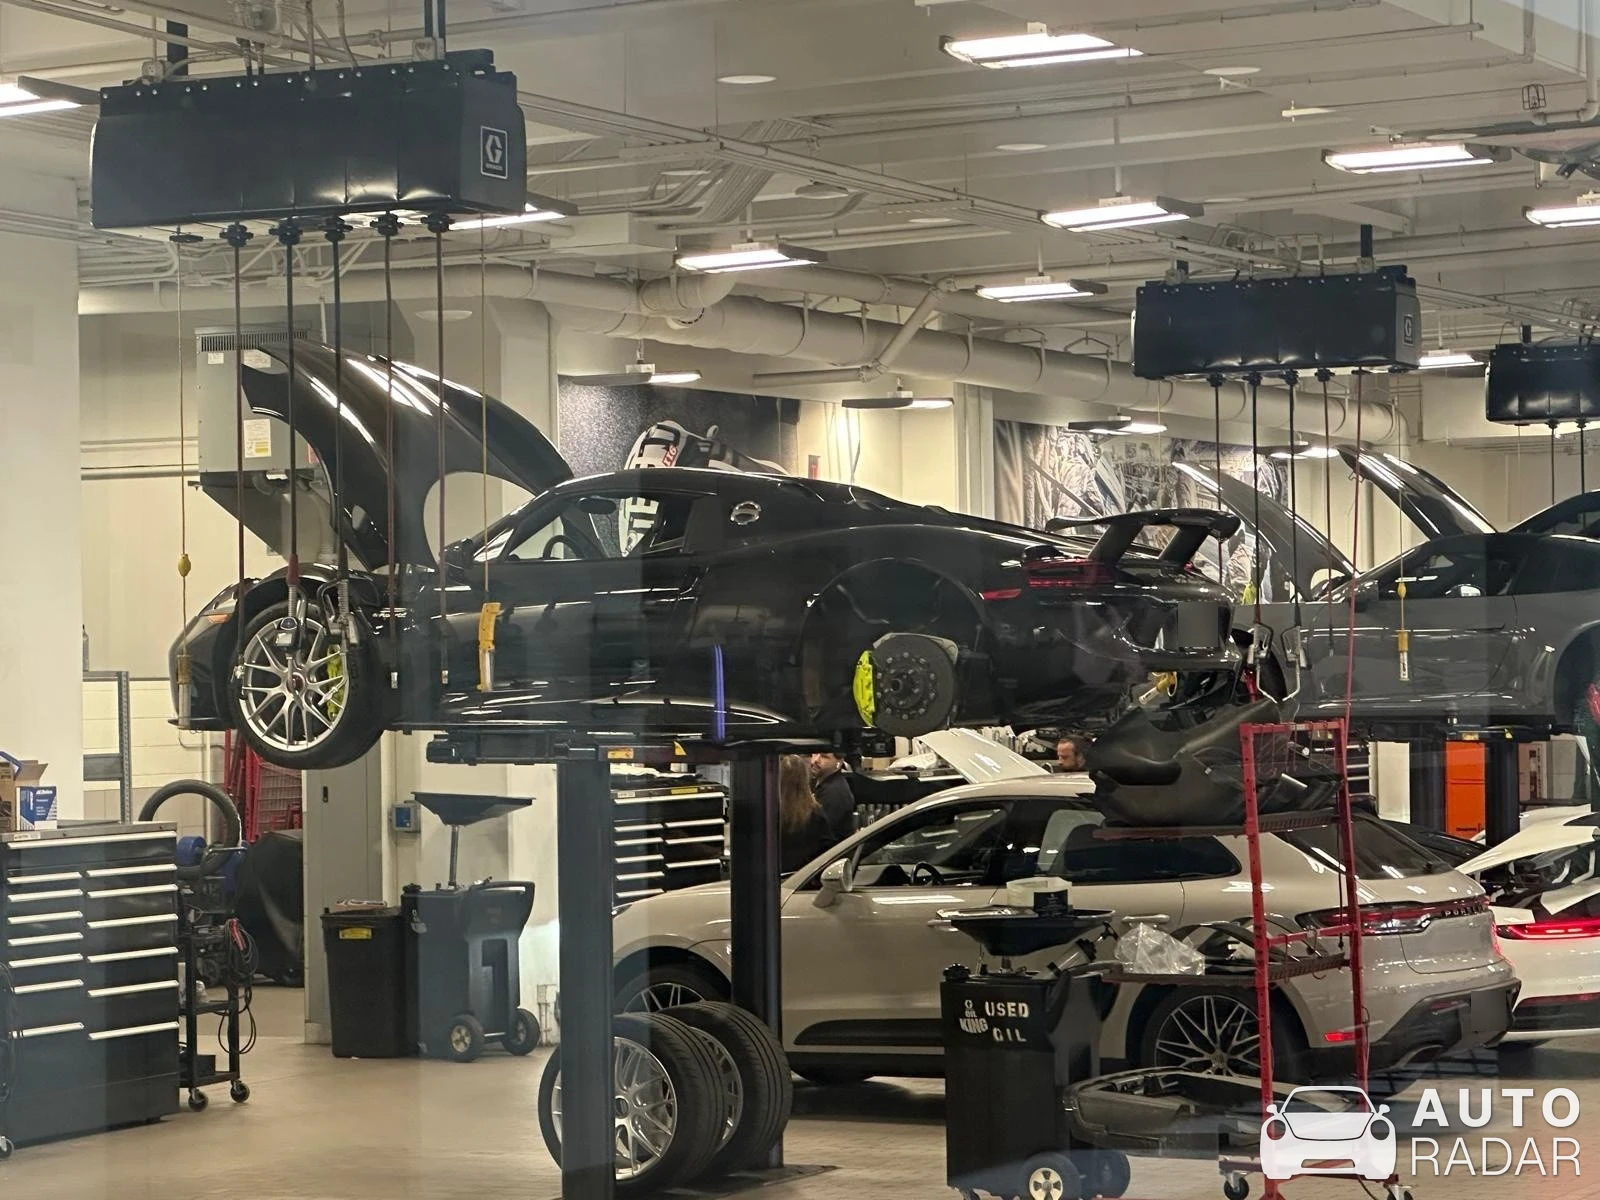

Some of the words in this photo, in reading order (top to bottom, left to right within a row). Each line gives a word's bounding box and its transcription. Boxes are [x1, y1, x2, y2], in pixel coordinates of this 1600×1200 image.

[965, 1010, 978, 1018] OIL
[985, 1001, 1030, 1018] USED
[959, 1018, 989, 1033] KING
[992, 1028, 1027, 1042] OIL
